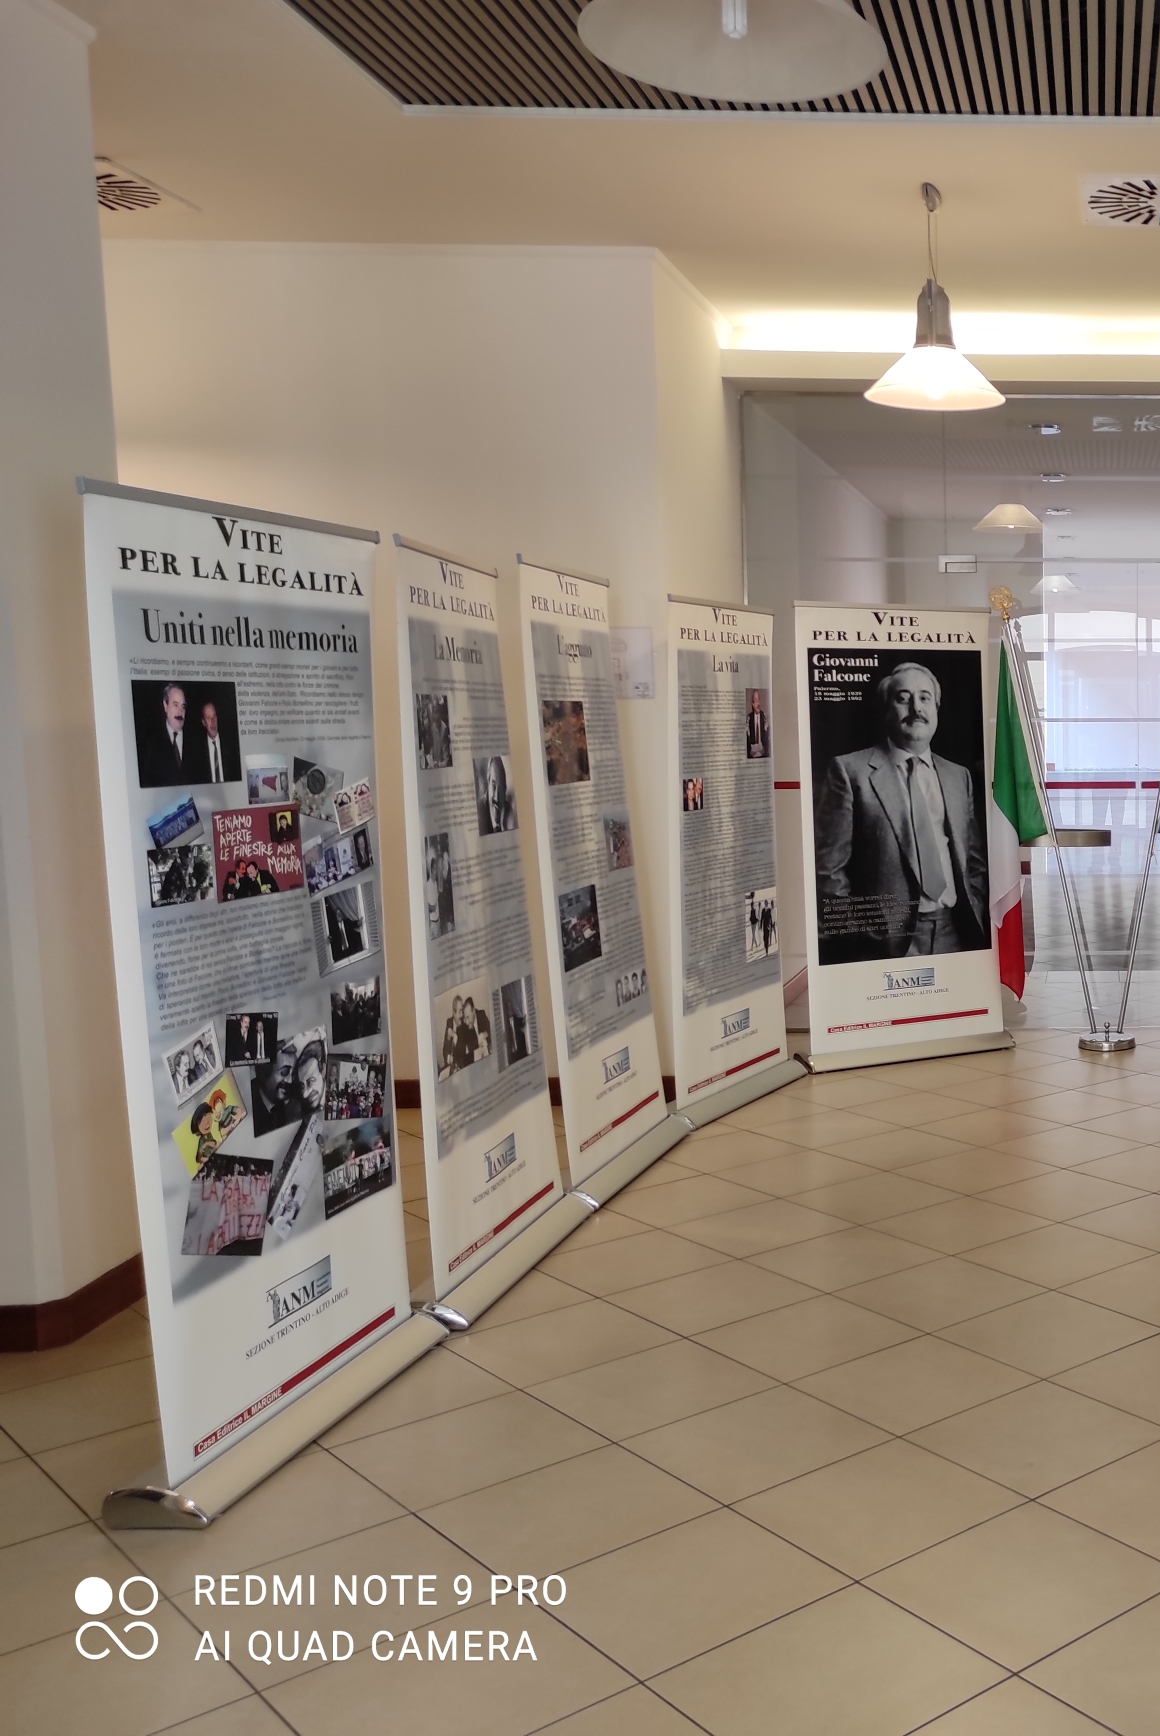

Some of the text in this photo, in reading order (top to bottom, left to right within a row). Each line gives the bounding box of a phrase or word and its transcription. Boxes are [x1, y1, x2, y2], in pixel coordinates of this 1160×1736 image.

[118, 547, 364, 596] PER LA LEGALITÀ
[409, 585, 495, 621] PER LA LEGALITÀ
[531, 594, 607, 623] PER LA LEGALITÀ
[141, 608, 358, 653] Uniti nella memoria
[680, 627, 768, 647] PER LA LEGALITÀ
[812, 630, 976, 644] PER LA LEGALITÀ
[712, 655, 739, 673] La vita
[812, 653, 879, 667] Giovanni
[813, 669, 871, 682] Falcone
[220, 829, 252, 848] APERTE
[220, 848, 229, 861] LE
[277, 843, 296, 855] ALLA
[894, 977, 920, 987] ANM
[280, 1280, 316, 1317] ANM
[245, 1287, 349, 1360] SEZIONE TRENTINO ALTO ADIGE
[197, 1386, 282, 1452] Casa Editrice IL MARGINE
